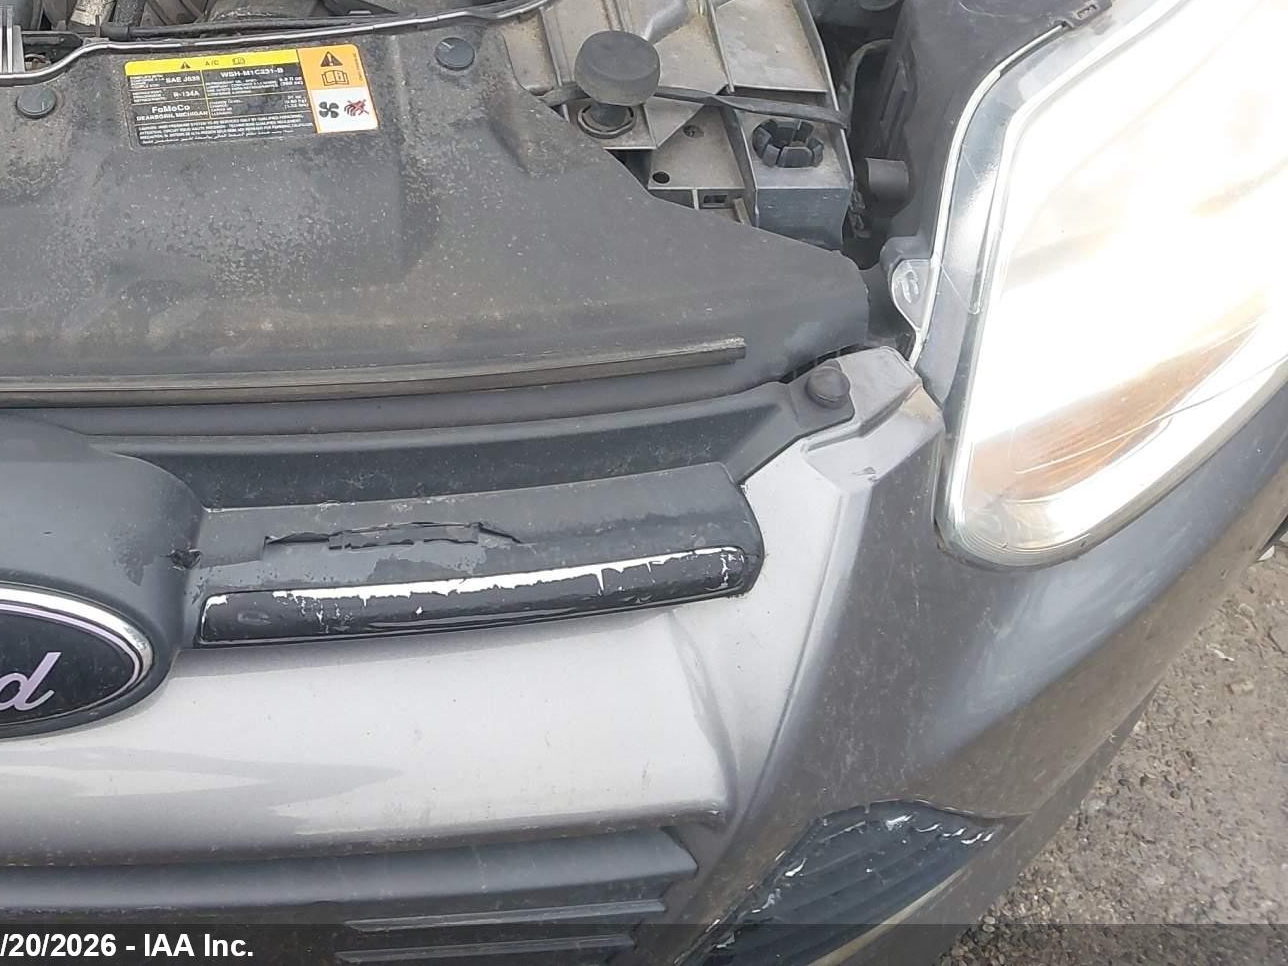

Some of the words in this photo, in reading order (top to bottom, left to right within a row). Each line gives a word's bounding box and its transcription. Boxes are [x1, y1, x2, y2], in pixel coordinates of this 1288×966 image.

[173, 90, 200, 98] R-134A
[152, 104, 190, 114] FoMoCo
[175, 110, 209, 119] MICHIGAN
